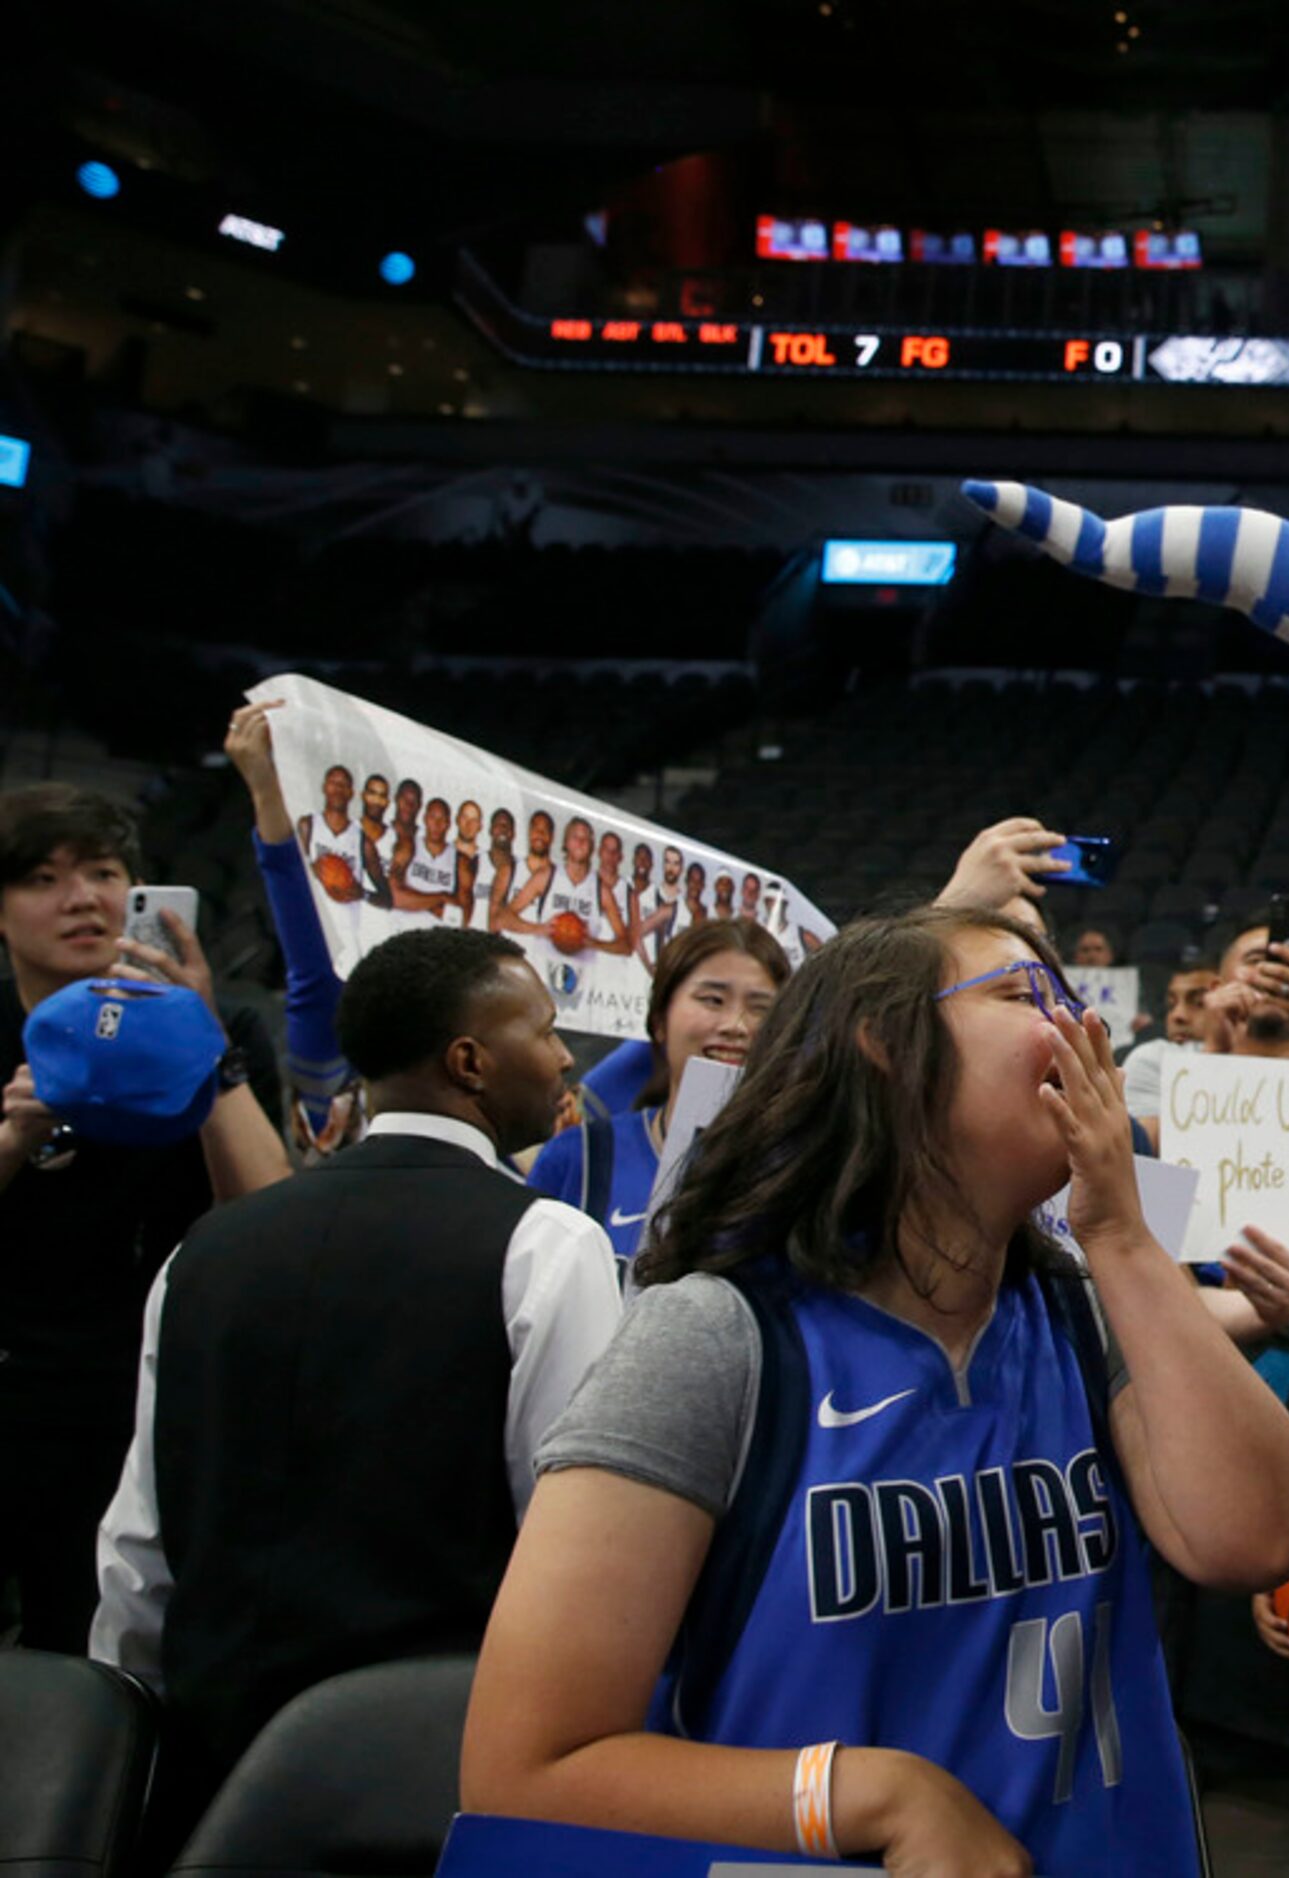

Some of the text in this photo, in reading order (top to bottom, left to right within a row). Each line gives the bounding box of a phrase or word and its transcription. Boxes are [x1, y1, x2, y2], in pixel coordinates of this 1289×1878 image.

[769, 332, 950, 369] TOL 7 FG
[1064, 341, 1088, 373] F
[1169, 1067, 1266, 1132] Could
[807, 1447, 1118, 1623] DALLAS
[1003, 1600, 1122, 1805] 41
